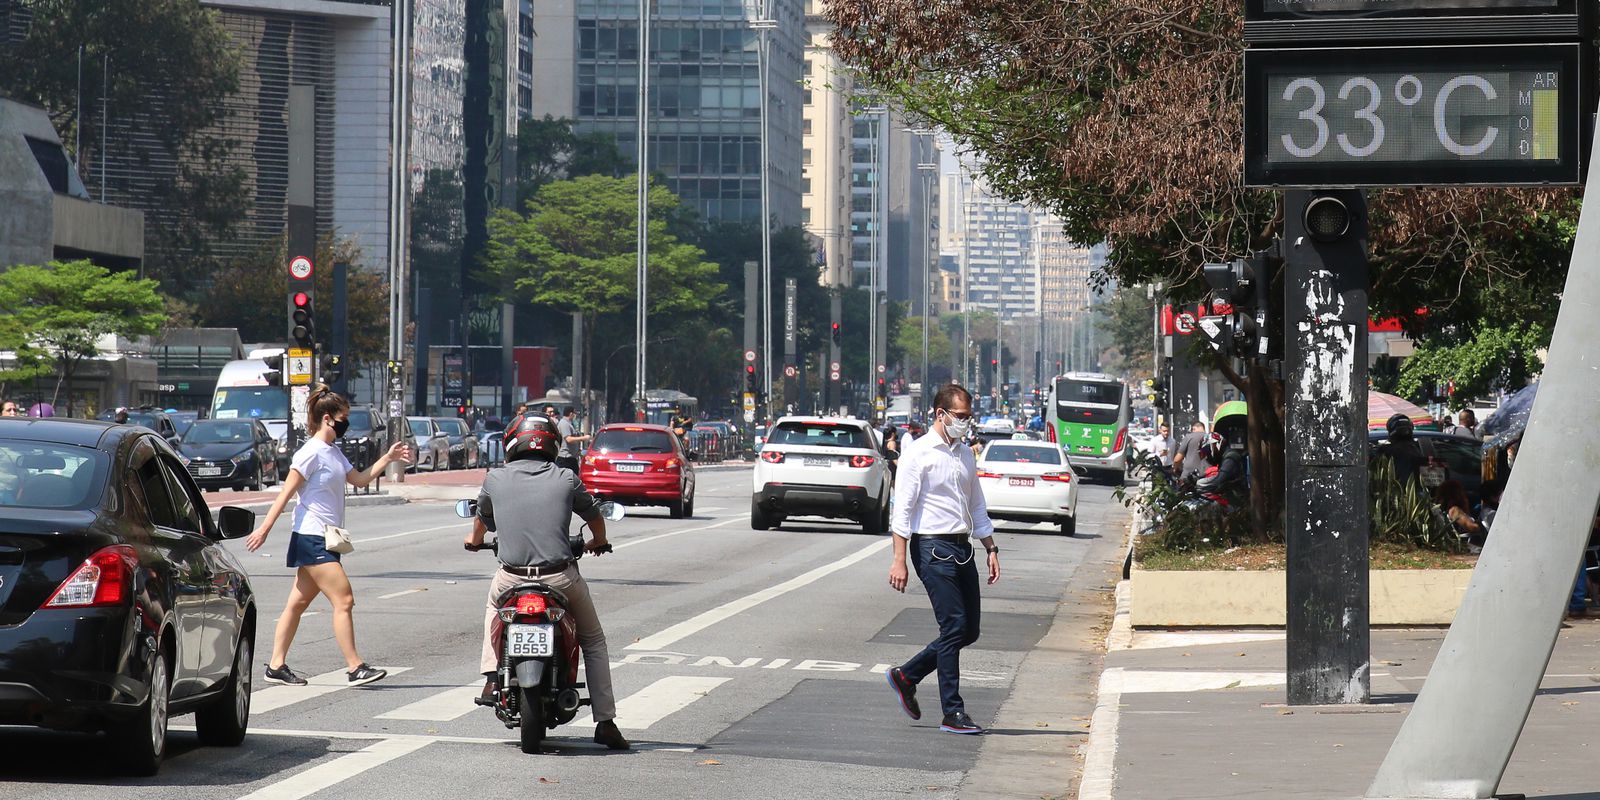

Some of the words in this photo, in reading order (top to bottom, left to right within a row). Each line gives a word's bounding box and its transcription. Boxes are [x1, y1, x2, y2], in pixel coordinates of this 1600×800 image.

[1532, 72, 1557, 88] AR
[1281, 74, 1499, 158] 33°C
[786, 296, 794, 331] Campinas
[1081, 385, 1097, 394] 317N
[513, 643, 548, 654] 8563
